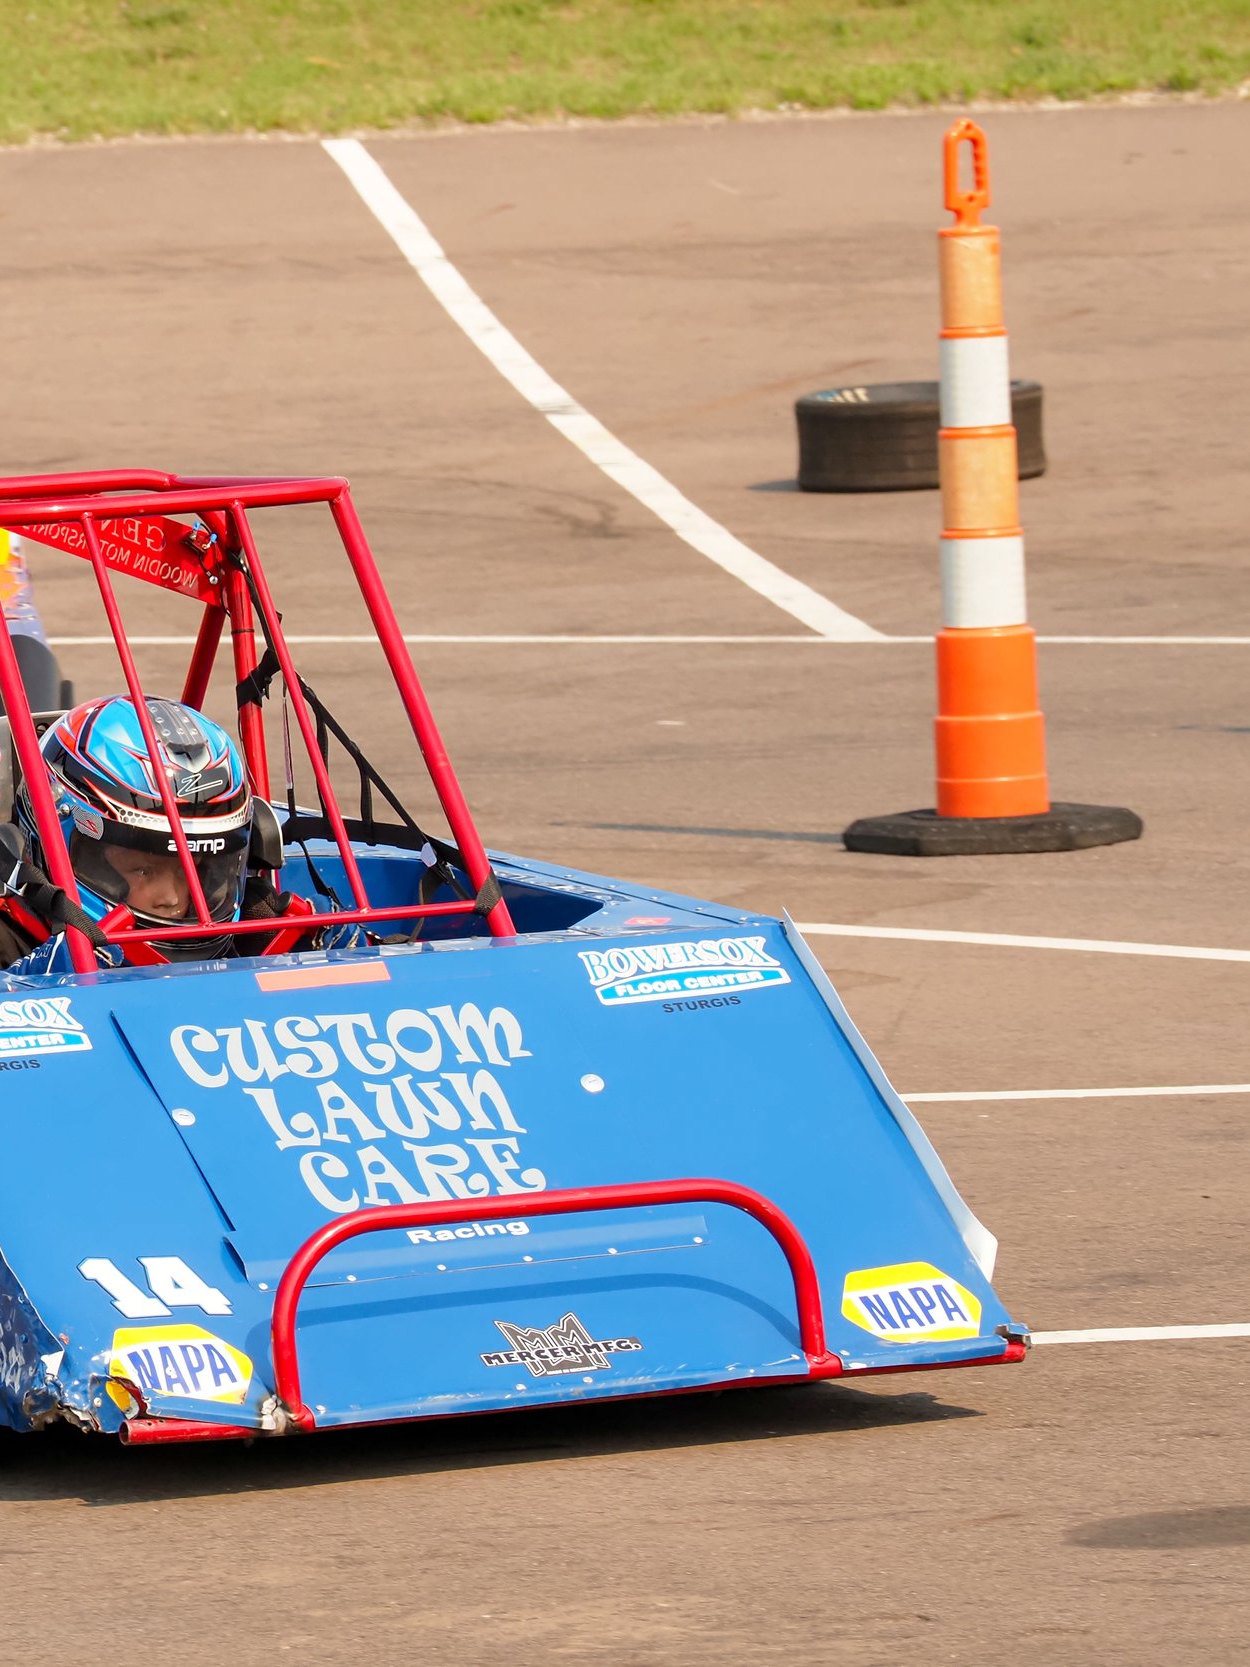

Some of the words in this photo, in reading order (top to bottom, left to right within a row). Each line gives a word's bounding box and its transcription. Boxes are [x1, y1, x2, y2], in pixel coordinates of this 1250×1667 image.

[579, 937, 780, 984] BOWERSOX
[615, 980, 682, 997] FLOOR
[684, 970, 764, 990] CENTER
[662, 995, 742, 1013] STURGIS
[169, 1002, 533, 1088] CUSTOM
[242, 1069, 527, 1151] LAWN
[299, 1136, 546, 1213] CARE
[406, 1220, 530, 1244] Racing
[77, 1255, 234, 1318] 14
[859, 1284, 969, 1330] NAPA
[127, 1343, 238, 1395] NAPA
[480, 1345, 583, 1367] MERCER
[582, 1338, 643, 1355] MFG.
